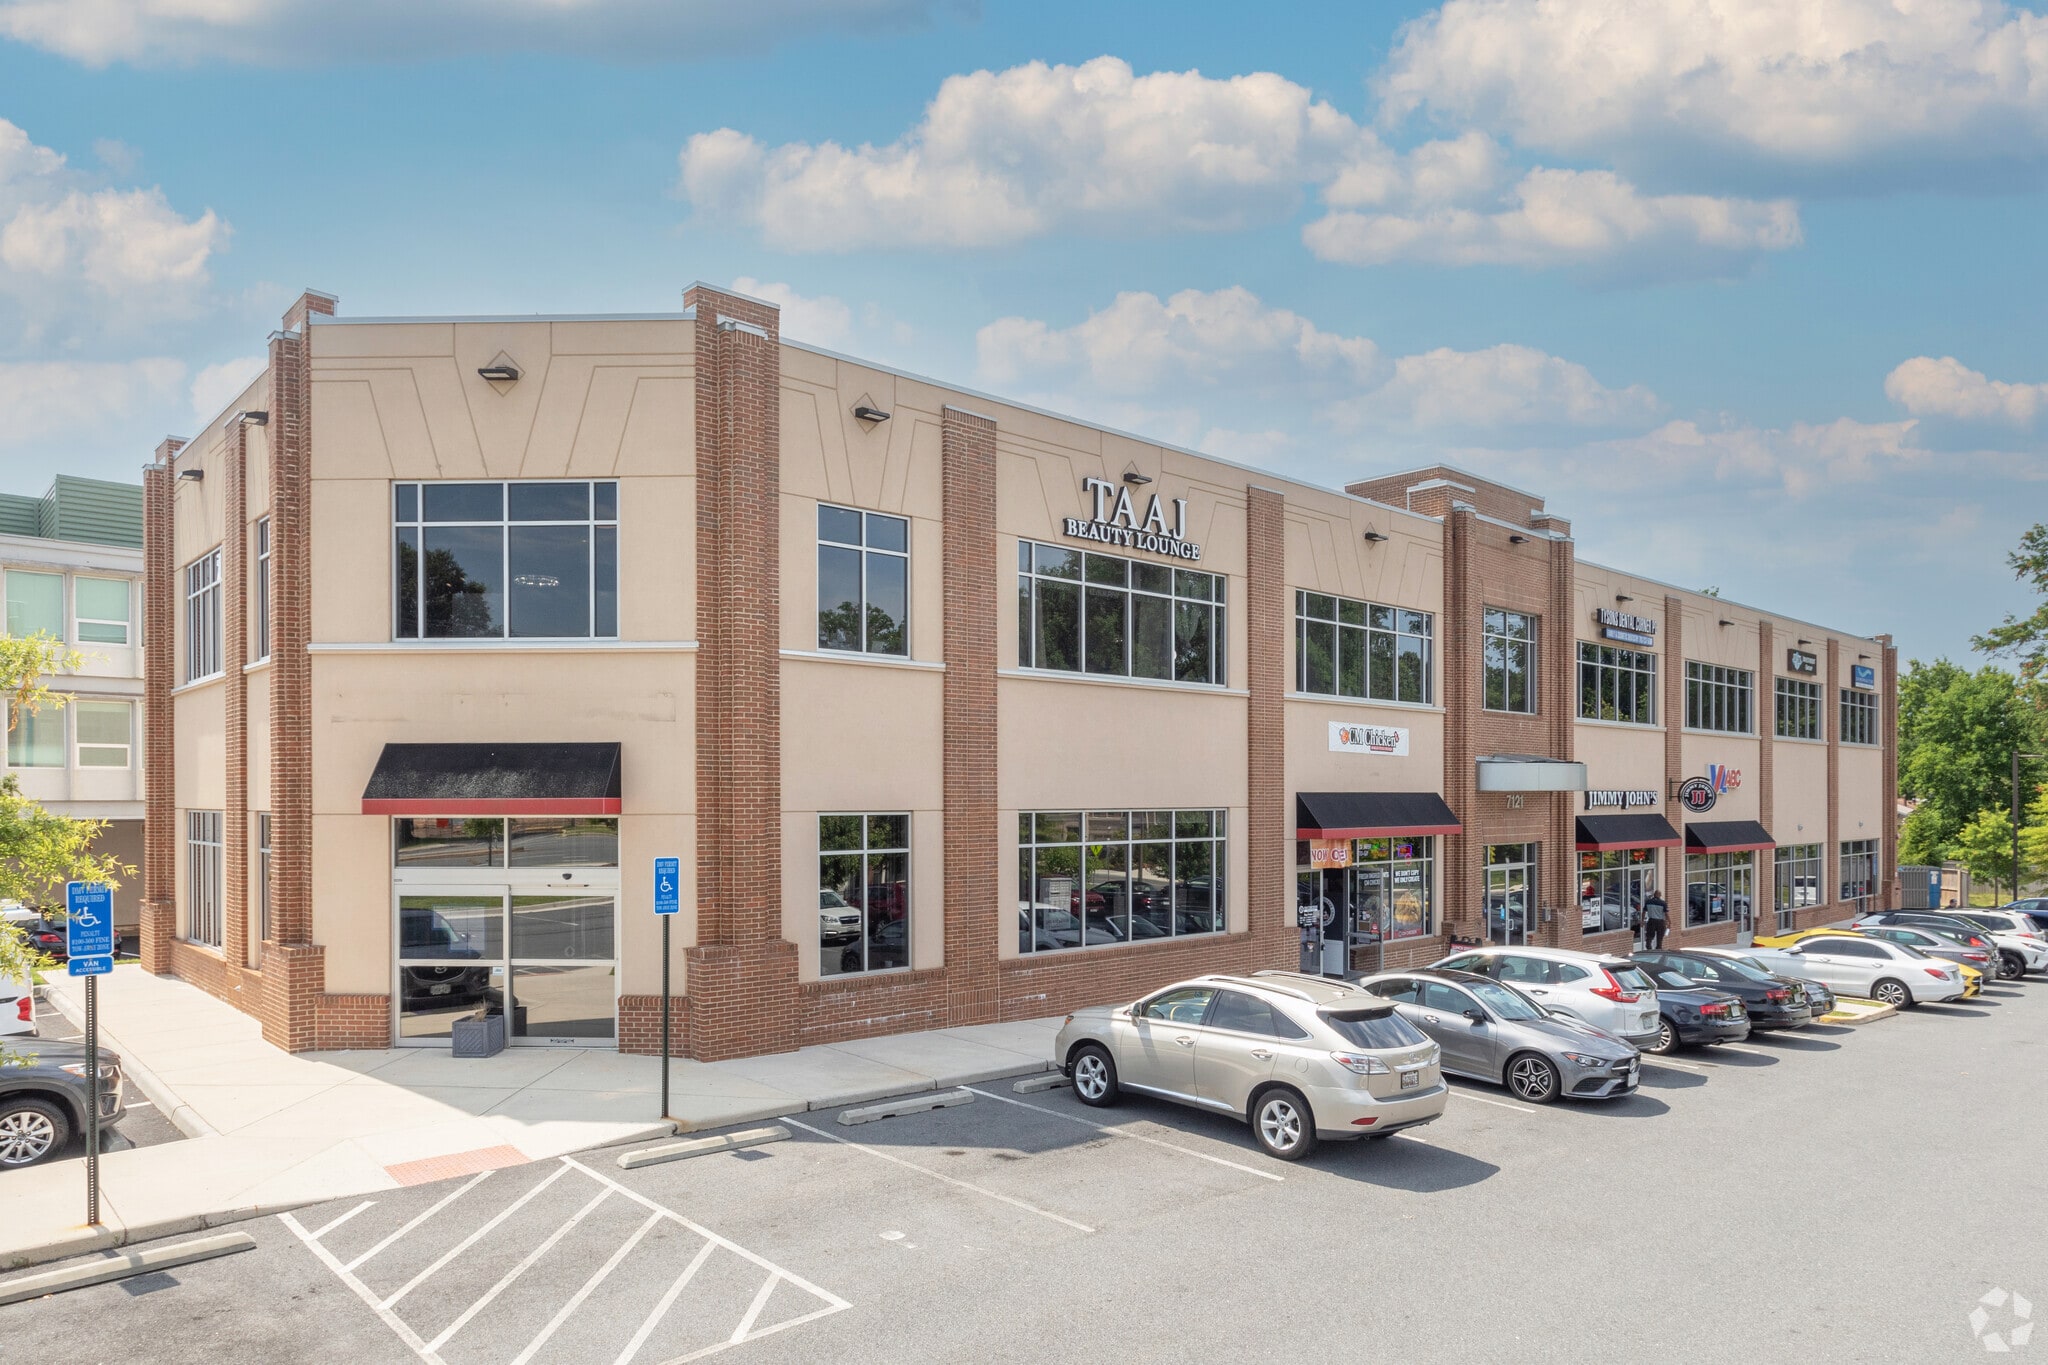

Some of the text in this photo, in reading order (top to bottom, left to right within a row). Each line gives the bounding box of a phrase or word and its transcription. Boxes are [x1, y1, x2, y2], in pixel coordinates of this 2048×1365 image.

[1083, 477, 1188, 541] TAAJ
[1064, 518, 1200, 560] BEAUTY LOUNGE
[1364, 729, 1396, 748] Chicken
[1725, 769, 1742, 787] ABC
[1506, 795, 1524, 808] 7121
[1587, 791, 1658, 810] JIMMY JOHN'S
[1691, 790, 1706, 804] JJ
[75, 895, 105, 904] REQUIRED
